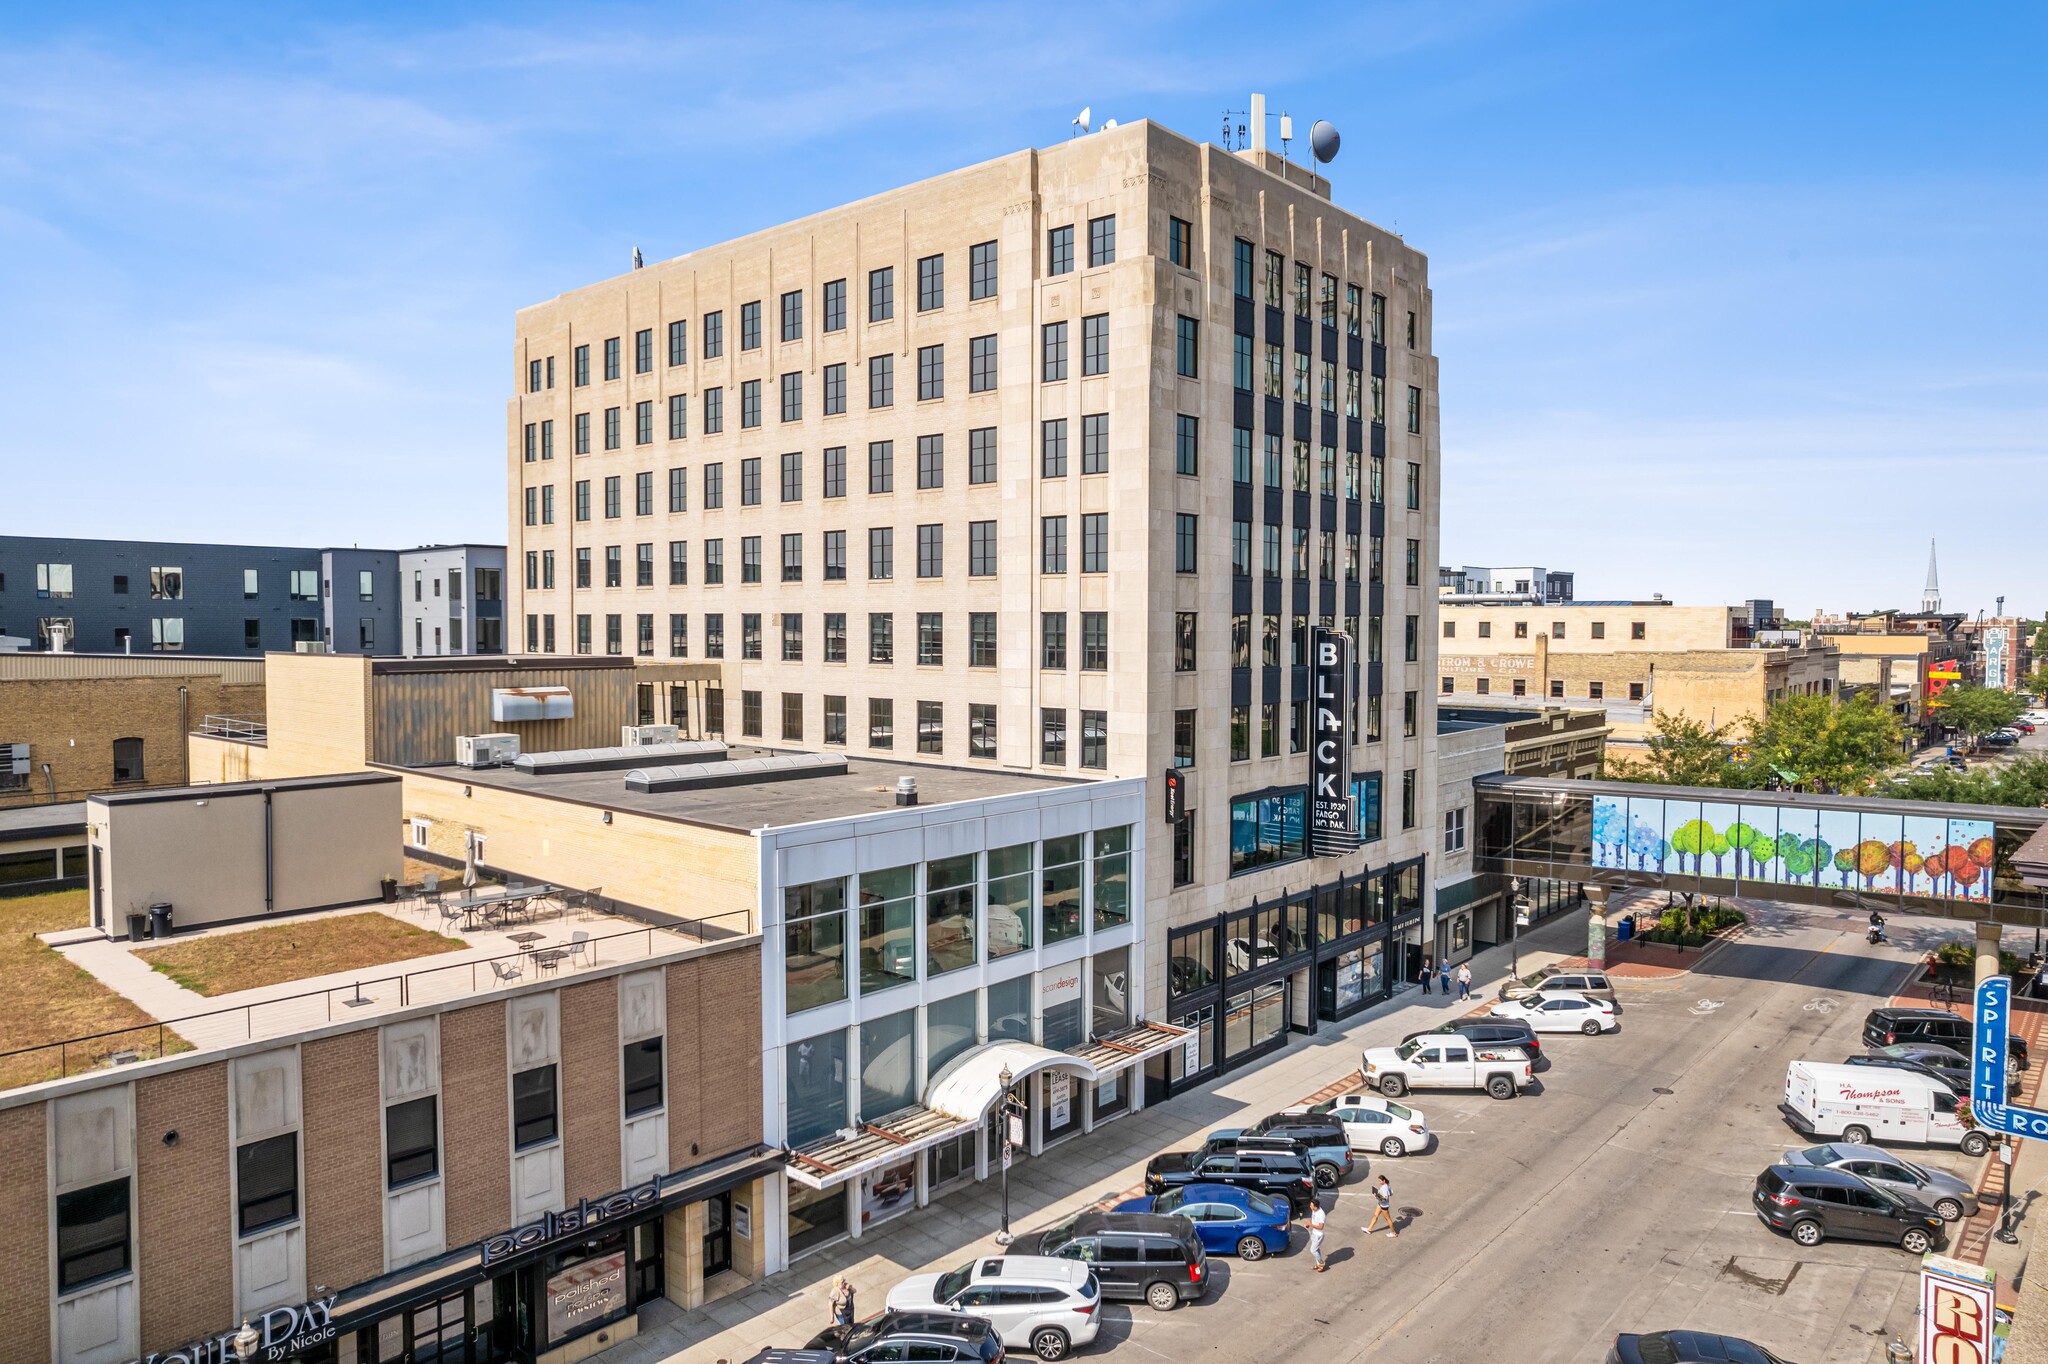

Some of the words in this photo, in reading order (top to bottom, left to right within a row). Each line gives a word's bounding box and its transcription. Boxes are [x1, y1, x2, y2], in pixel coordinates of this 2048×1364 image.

[1477, 658, 1487, 667] &
[1491, 658, 1535, 669] CROWE
[1317, 642, 1342, 798] BLACK
[1315, 810, 1339, 819] FARGO
[1316, 801, 1329, 809] EST.
[1330, 802, 1347, 811] 1930
[1315, 819, 1328, 827] NO.
[1329, 820, 1346, 829] DAK.
[1042, 976, 1079, 994] scandesign
[1980, 991, 1999, 1100] SPIRIT
[1052, 1072, 1069, 1085] LEASE
[1840, 1088, 1901, 1101] Thompson
[481, 1173, 662, 1267] polished
[554, 1269, 621, 1305] polished
[261, 1296, 337, 1350] DAY
[268, 1345, 286, 1361] By
[290, 1326, 336, 1353] Nicole
